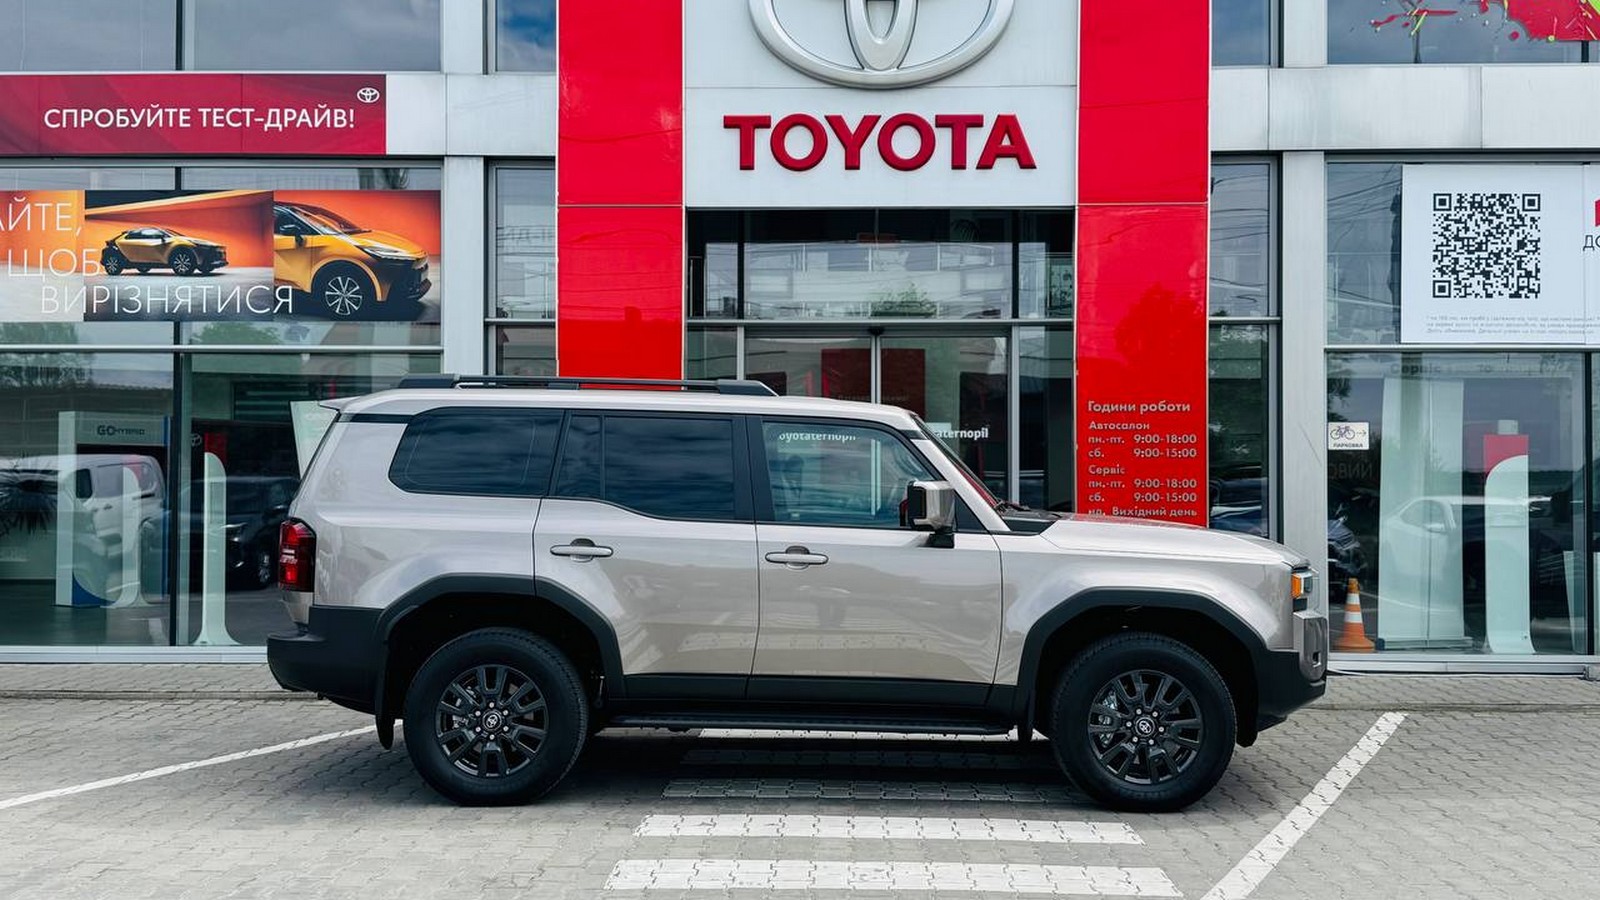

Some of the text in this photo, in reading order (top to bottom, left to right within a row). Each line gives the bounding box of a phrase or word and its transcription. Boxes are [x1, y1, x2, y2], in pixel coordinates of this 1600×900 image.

[44, 104, 355, 131] СПРОБУЙТЕ ТЕСТ-ДРАЙВ!
[723, 113, 1037, 171] TOYOTA
[7, 248, 101, 283] ЩОБ
[41, 285, 293, 314] ВИРІЗНЯТИСЯ
[1087, 400, 1191, 415] Години роботи
[1088, 420, 1150, 430] Автосалон
[1132, 434, 1197, 444] 9:00-18:00
[1088, 447, 1197, 458] сб. 9:00-15:00
[1088, 464, 1126, 476] Сервіс
[1132, 479, 1197, 489] 9:00-18:00
[1088, 492, 1197, 502] сб. 9:00-15:00
[1112, 506, 1167, 517] Вихідний
[1169, 508, 1197, 517] день
